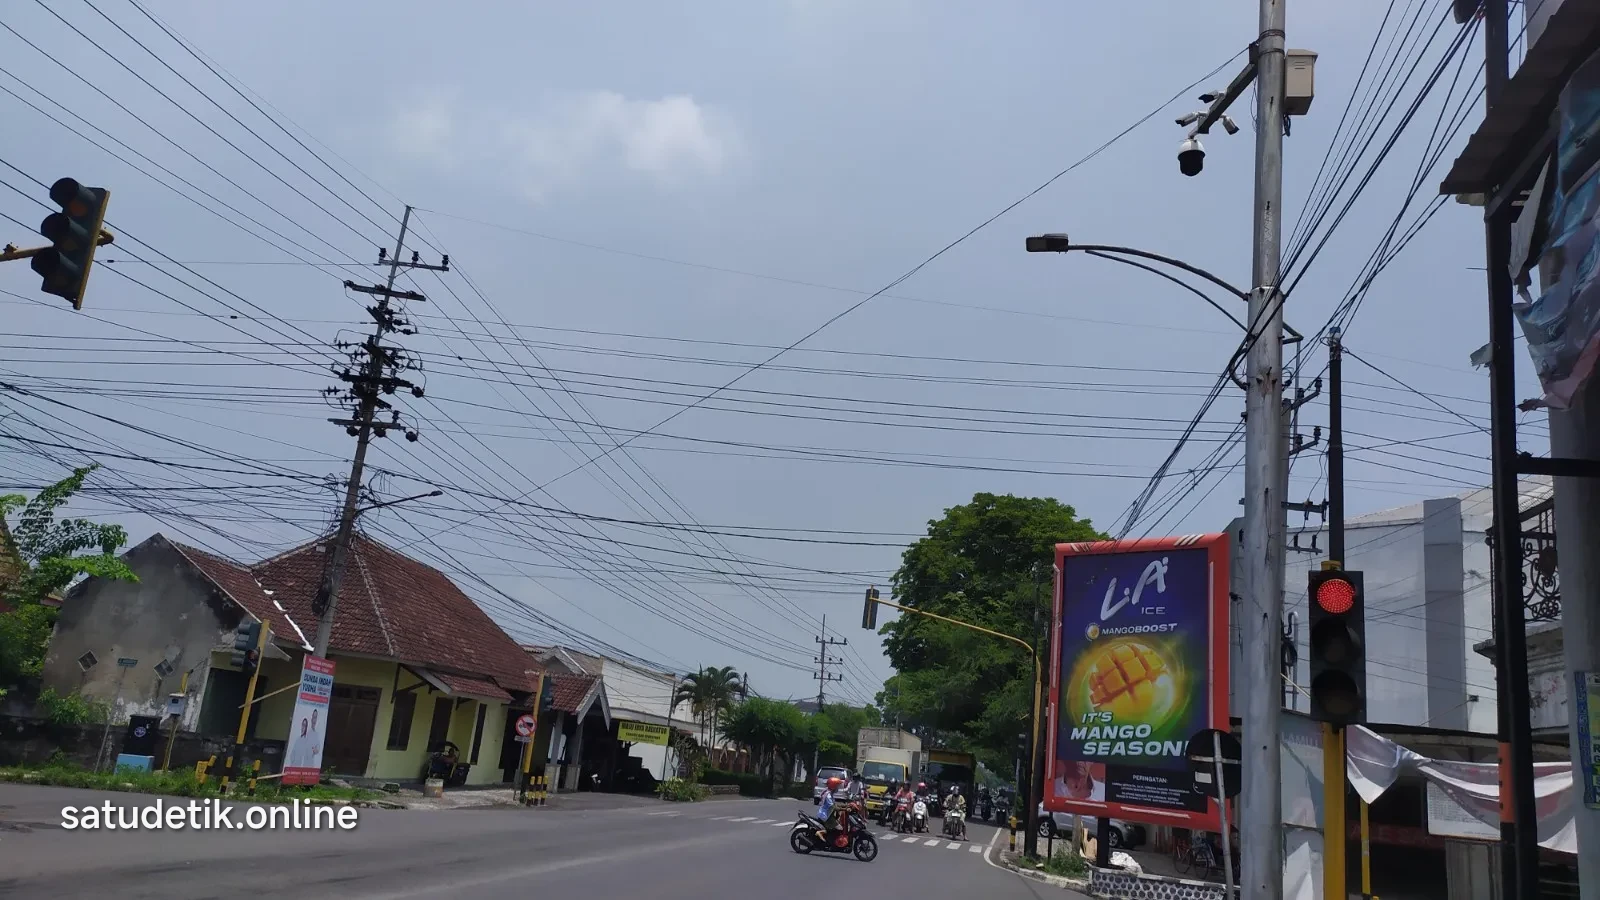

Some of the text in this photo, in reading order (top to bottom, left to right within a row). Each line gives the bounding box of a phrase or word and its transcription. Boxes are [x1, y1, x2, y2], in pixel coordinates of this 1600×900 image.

[1141, 606, 1166, 615] ICE
[1101, 623, 1178, 635] MANGOBOOST
[1082, 711, 1112, 723] IT'S
[1070, 724, 1152, 740] MANGO
